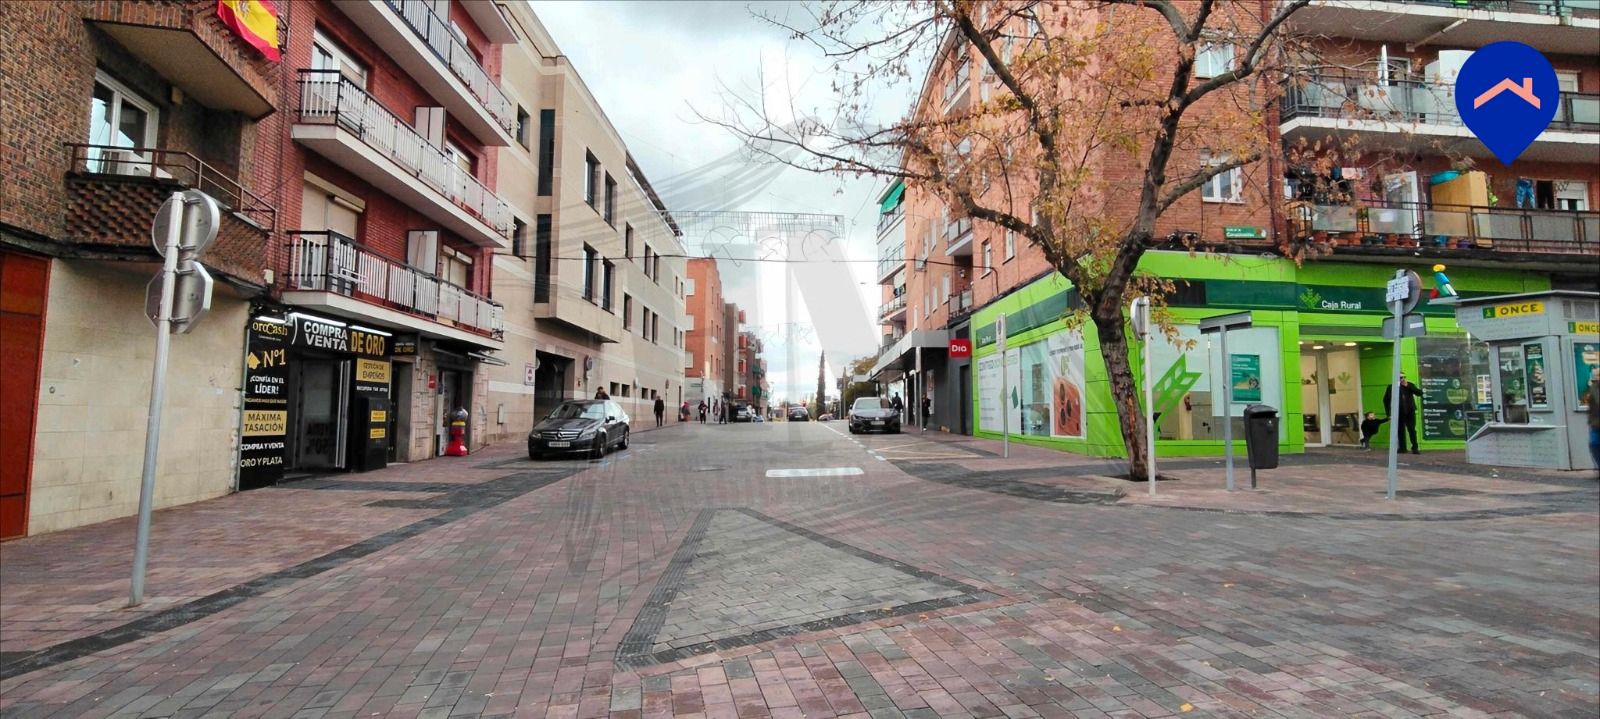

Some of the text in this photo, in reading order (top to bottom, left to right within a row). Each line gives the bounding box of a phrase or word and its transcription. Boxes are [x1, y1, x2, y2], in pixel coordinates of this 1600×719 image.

[1321, 300, 1362, 310] Caja Rural
[1500, 304, 1538, 316] ONCE
[252, 322, 288, 336] oroCash
[303, 321, 348, 340] COMPRA
[305, 333, 348, 352] VENTA
[351, 331, 385, 356] DE ORO
[255, 383, 280, 395] LÍDER!
[248, 413, 282, 422] MÁXIMA
[245, 423, 284, 432] TASACIÓN
[240, 443, 264, 451] COMPRA
[240, 458, 257, 467] ORO
[262, 456, 283, 466] PLATA
